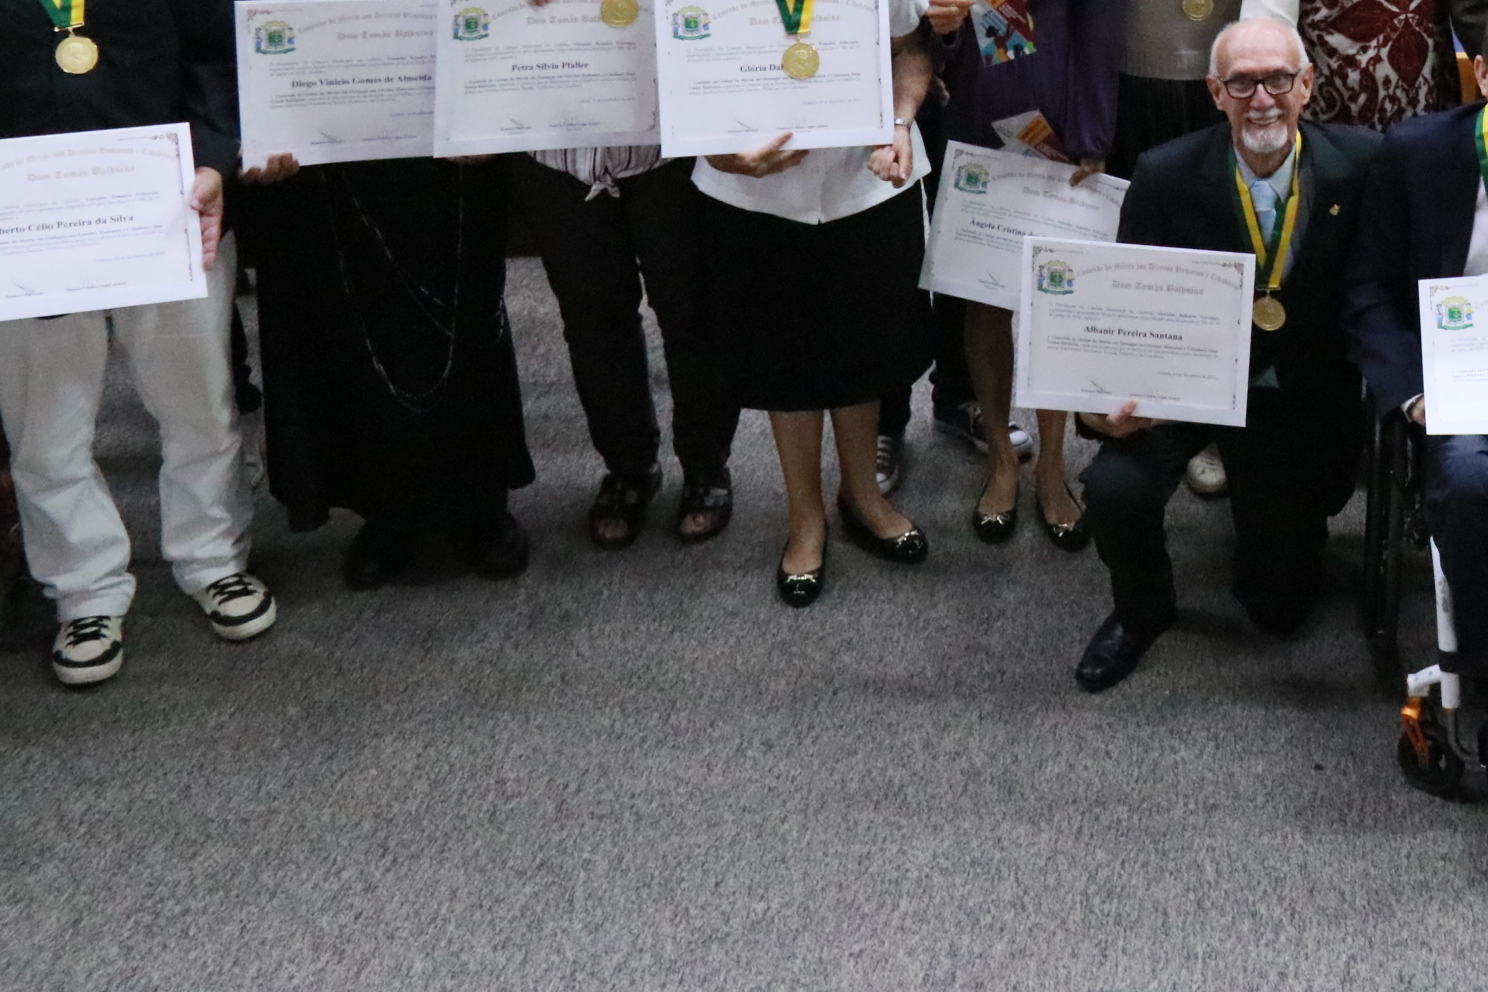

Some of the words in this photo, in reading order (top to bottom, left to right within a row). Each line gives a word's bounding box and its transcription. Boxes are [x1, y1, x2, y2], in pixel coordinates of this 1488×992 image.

[512, 64, 534, 72] Petra
[536, 63, 559, 71] Silvia
[562, 62, 589, 70] Pfaller
[740, 63, 767, 73] Glória
[769, 63, 784, 72] Dal
[292, 80, 317, 90] Diego
[352, 77, 382, 85] Gomes
[384, 75, 394, 83] de
[397, 74, 432, 82] Almeida
[28, 217, 54, 231] Célio
[57, 217, 92, 229] Pereira
[95, 216, 107, 224] da
[110, 214, 134, 223] Silva
[970, 218, 995, 230] Ângela
[997, 224, 1025, 236] Cristina
[1112, 281, 1132, 289] Dom
[1084, 326, 1115, 336] Albanir
[1117, 329, 1147, 338] Pereira
[1149, 331, 1183, 341] Santana
